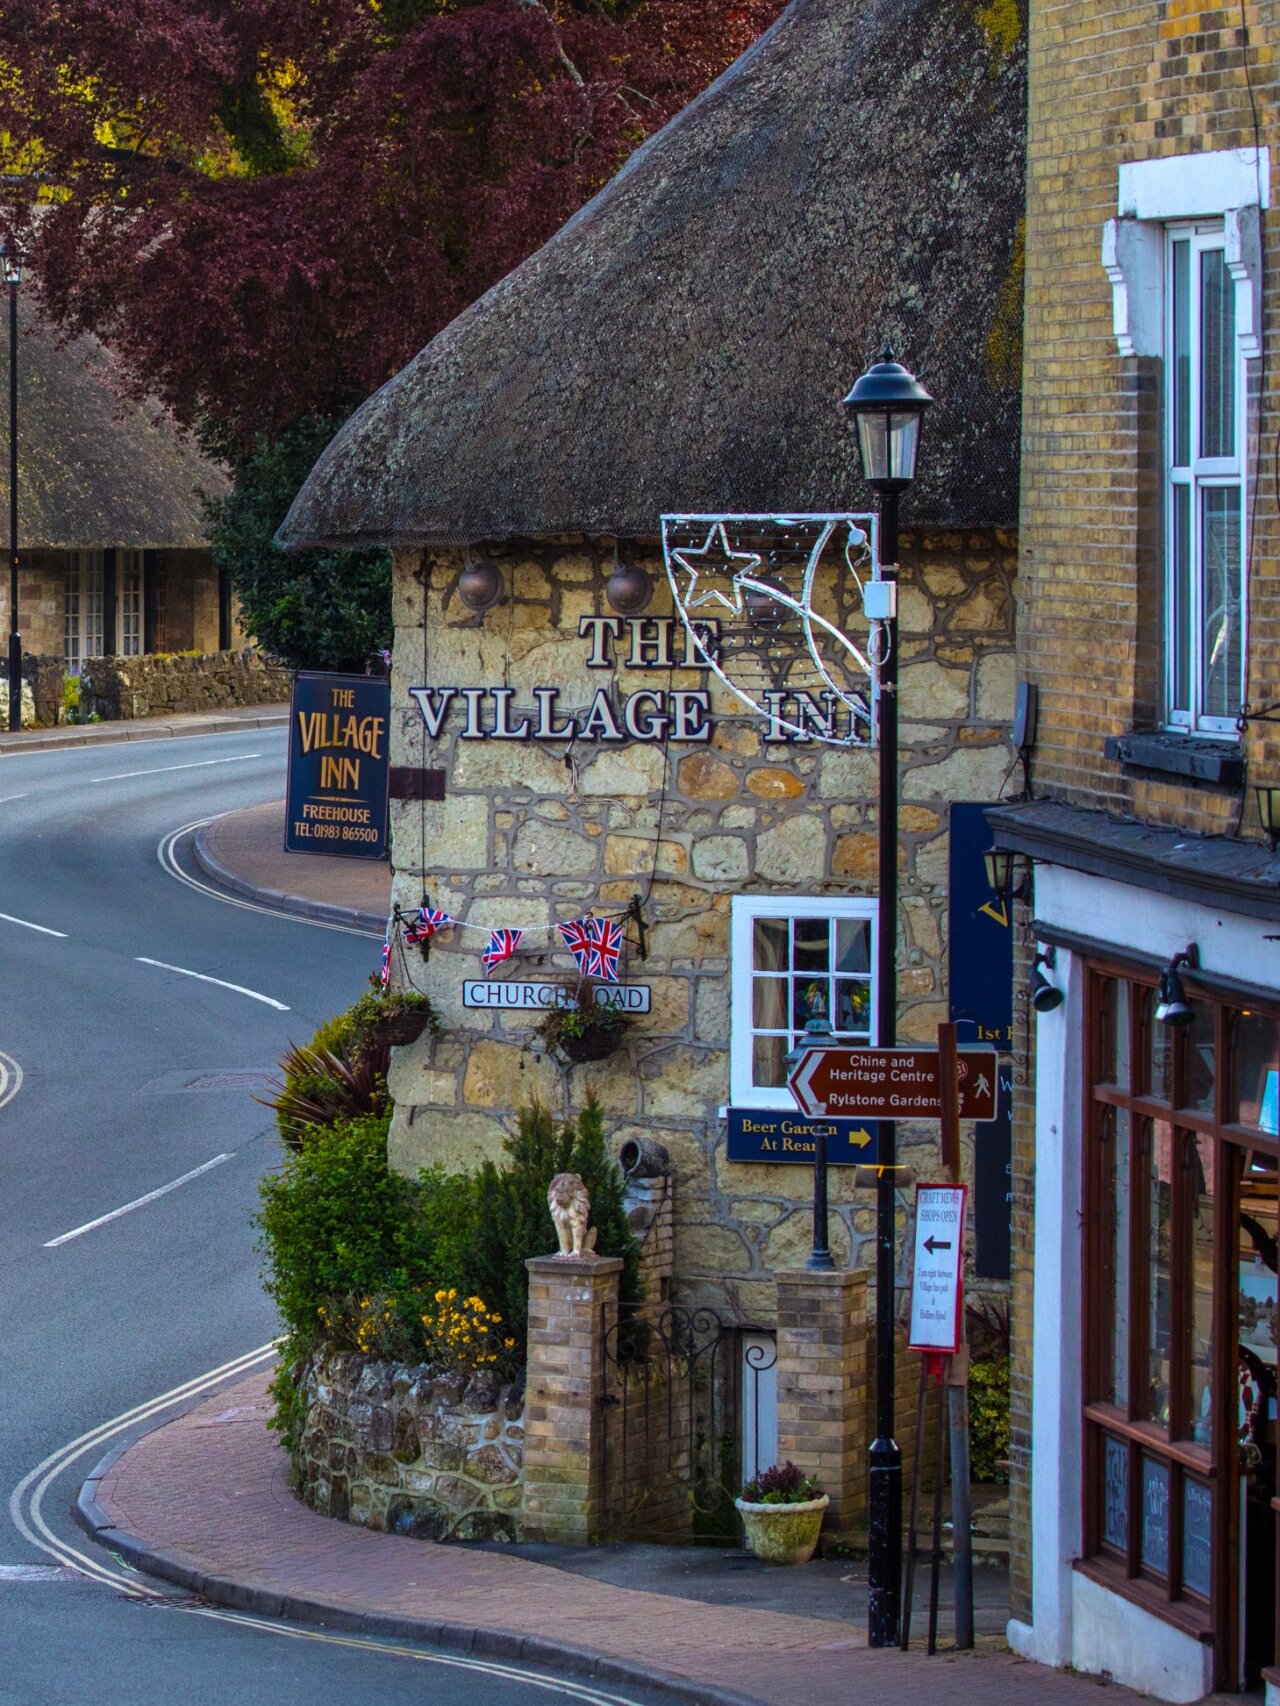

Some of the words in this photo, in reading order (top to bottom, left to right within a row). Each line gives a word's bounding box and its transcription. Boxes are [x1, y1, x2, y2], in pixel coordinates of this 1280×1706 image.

[579, 616, 720, 670] THE
[332, 688, 355, 708] THE
[409, 687, 713, 743] VILLAGE
[763, 690, 878, 744] INN
[299, 711, 384, 760] VILLAGE
[320, 756, 360, 790] INN
[303, 803, 371, 824] FREEHOUSE
[342, 827, 379, 843] 865500
[595, 988, 644, 1008] OAD
[977, 1025, 1001, 1040] 1st
[850, 1055, 887, 1068] Chine
[891, 1056, 915, 1068] and
[830, 1069, 885, 1084] Heritage
[890, 1070, 934, 1082] Centre
[829, 1093, 885, 1108] Rylstone
[890, 1094, 942, 1107] Gardens
[742, 1119, 776, 1133] Beer
[760, 1138, 777, 1151] At
[782, 1138, 817, 1152] Rear
[920, 1191, 939, 1204] CRAFT
[920, 1209, 940, 1222] SHOPS
[940, 1210, 958, 1222] OPEN
